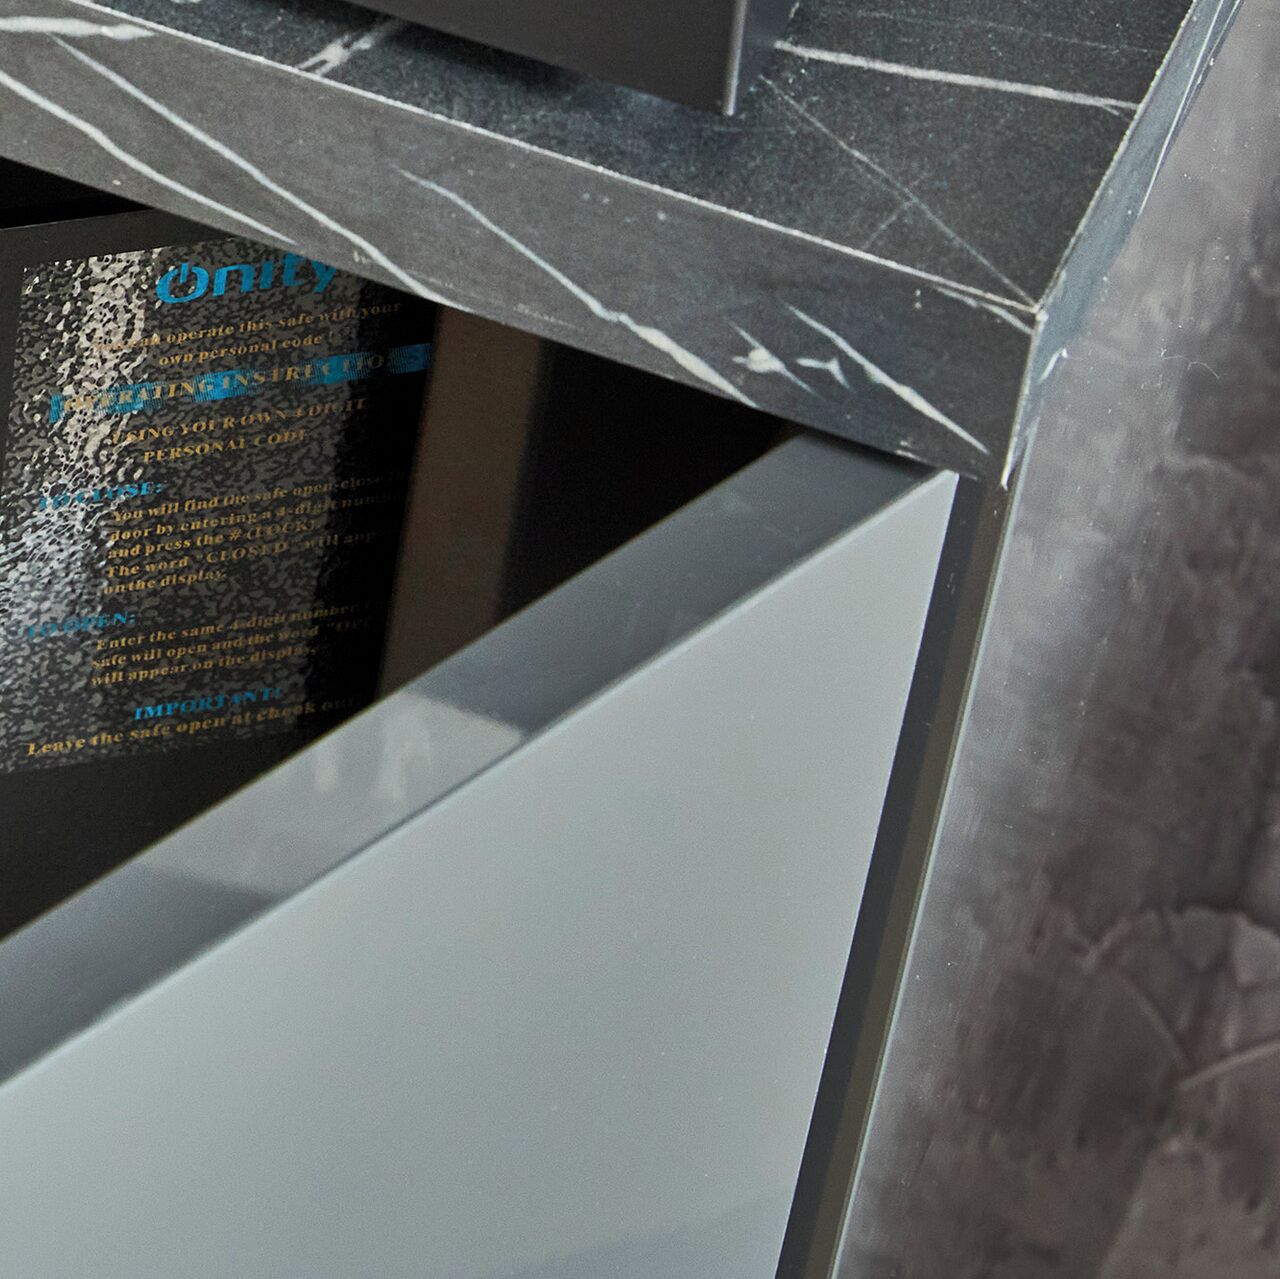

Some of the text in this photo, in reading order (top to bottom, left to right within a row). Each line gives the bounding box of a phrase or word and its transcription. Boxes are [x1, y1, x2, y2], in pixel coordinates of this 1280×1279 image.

[156, 252, 337, 305] Onity
[166, 324, 236, 346] operate
[239, 317, 274, 333] this
[158, 333, 323, 367] own personal code
[143, 437, 246, 464] PERSONAL
[147, 502, 180, 519] will
[183, 496, 220, 514] find
[110, 525, 152, 543] door
[156, 521, 175, 538] by
[179, 510, 258, 533] entering
[108, 545, 142, 561] and
[145, 539, 192, 558] press
[195, 532, 225, 549] the
[105, 563, 141, 579] The
[145, 555, 191, 573] word
[96, 634, 146, 652] Enter
[149, 629, 178, 644] the
[180, 623, 226, 639] same
[91, 653, 127, 671] safe
[131, 648, 163, 664] will
[166, 643, 208, 660] open
[211, 638, 242, 653] and
[91, 672, 124, 688] will
[127, 663, 189, 683] appear
[27, 737, 87, 757] Leave
[90, 729, 125, 747] the
[128, 721, 172, 741] safe
[176, 717, 227, 738] open
